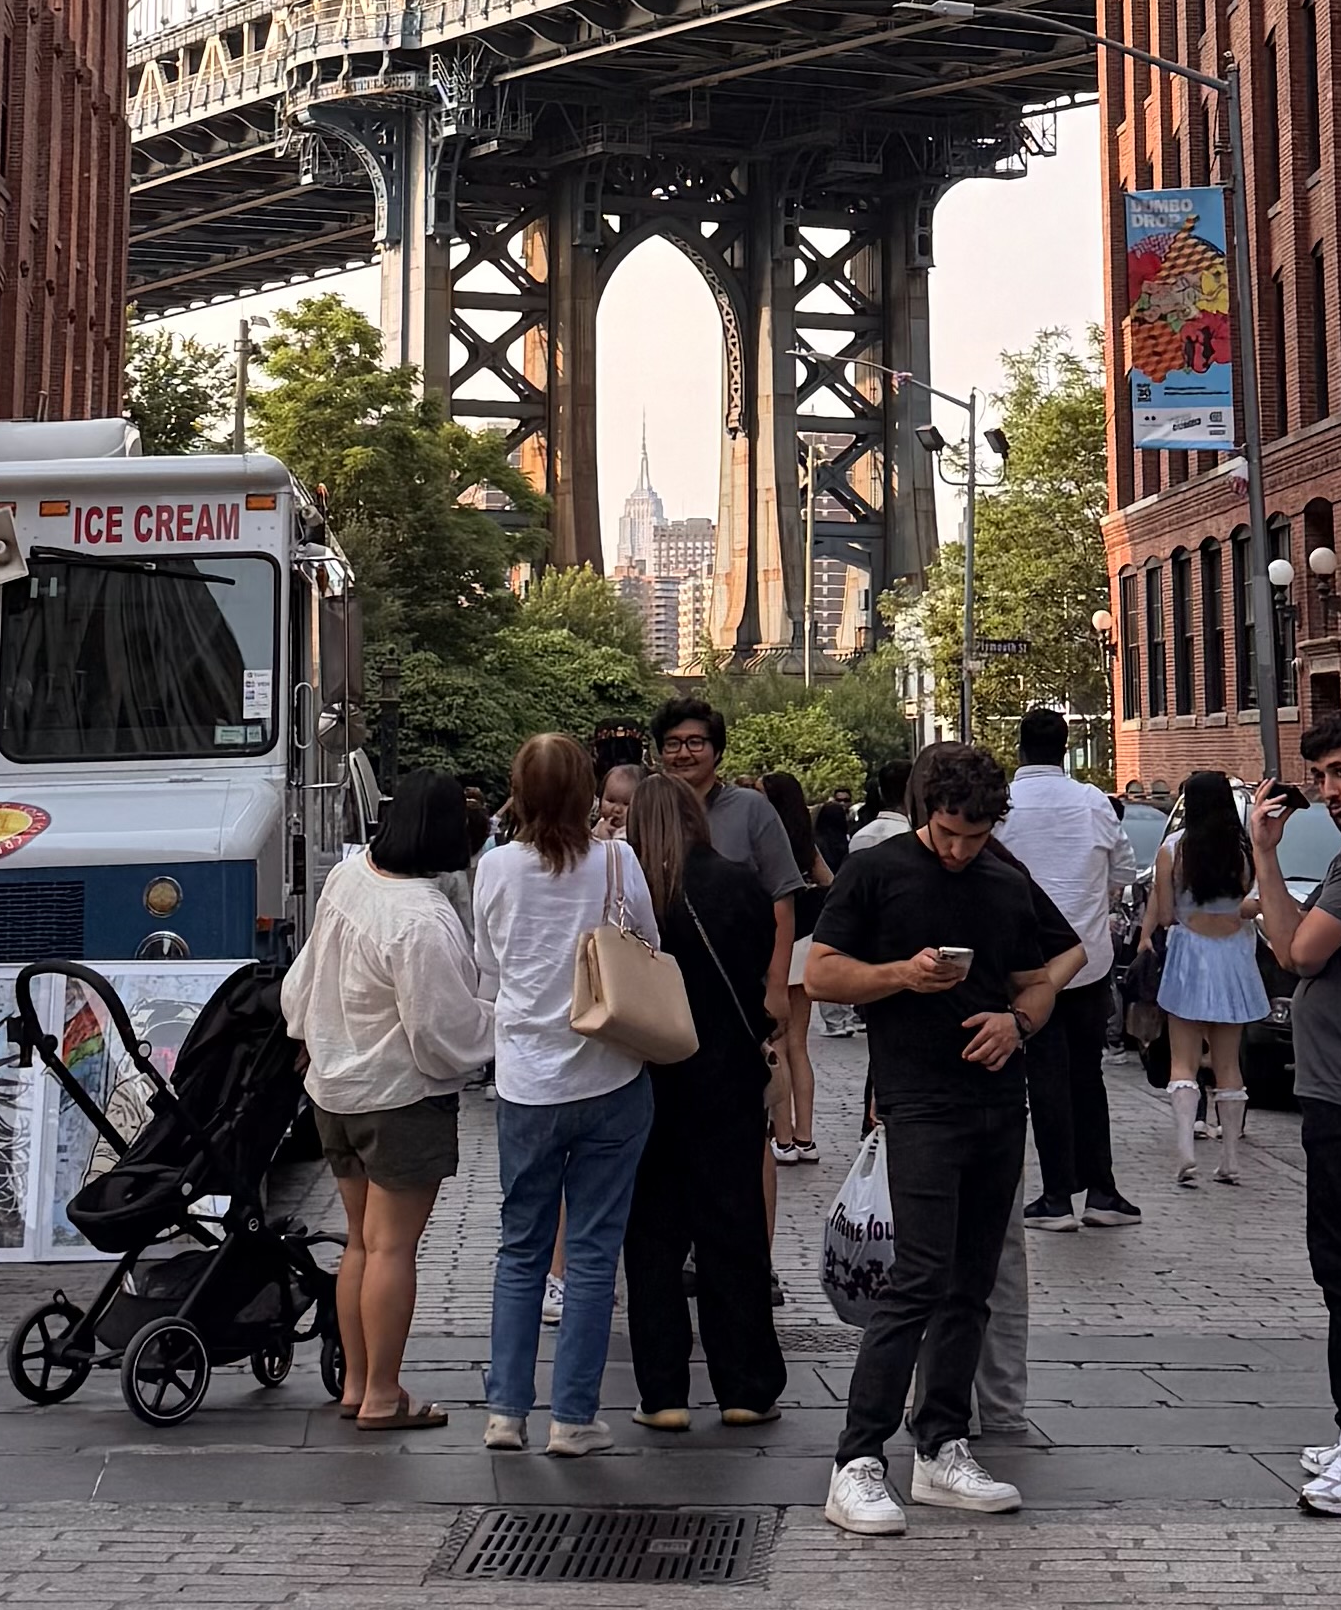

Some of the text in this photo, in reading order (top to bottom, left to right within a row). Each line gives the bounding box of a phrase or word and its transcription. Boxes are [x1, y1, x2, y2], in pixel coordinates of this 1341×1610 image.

[1130, 198, 1194, 213] DUMBO
[1131, 213, 1181, 228] DROP
[74, 503, 240, 545] ICE CREAM
